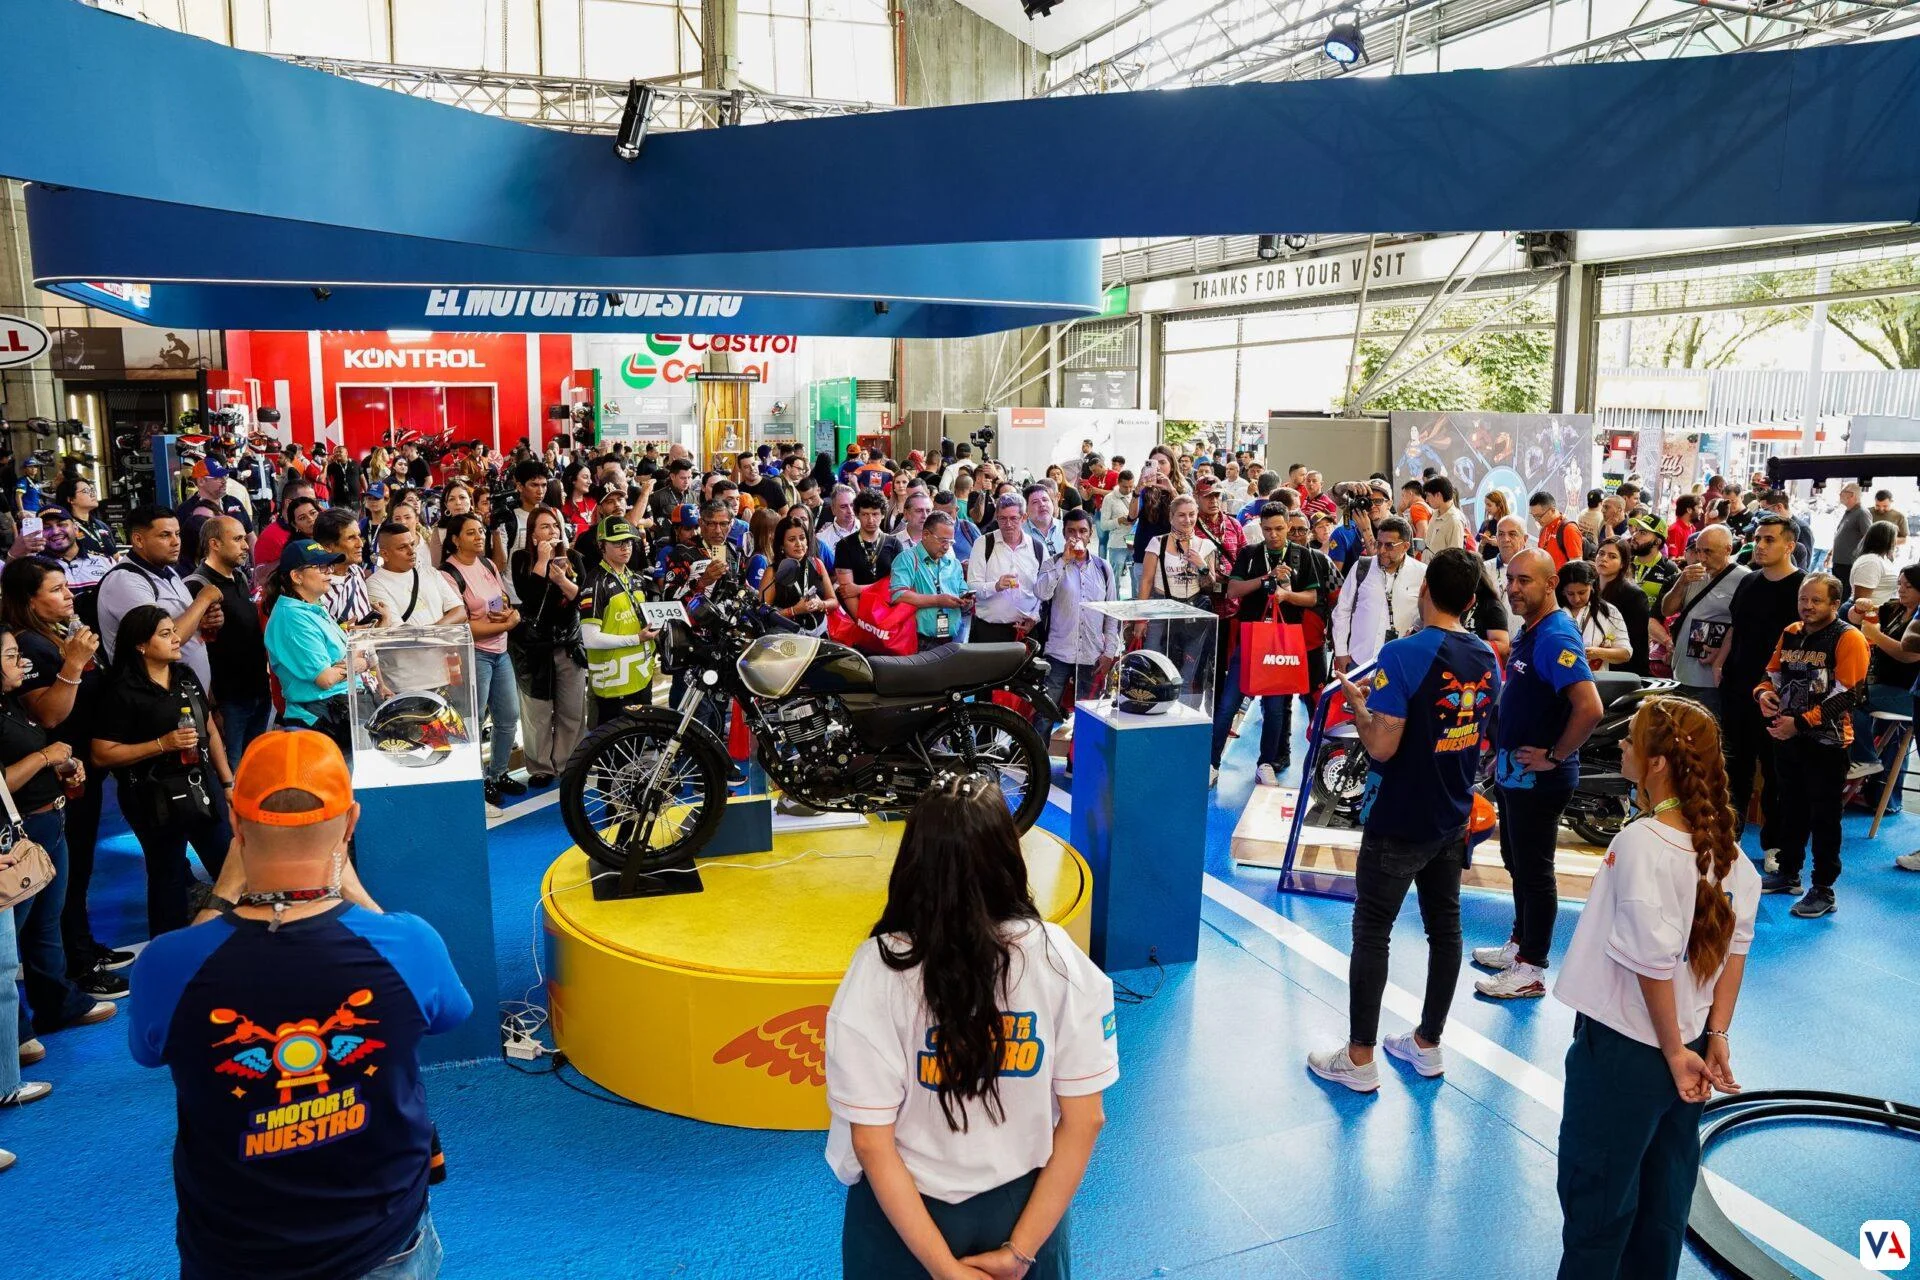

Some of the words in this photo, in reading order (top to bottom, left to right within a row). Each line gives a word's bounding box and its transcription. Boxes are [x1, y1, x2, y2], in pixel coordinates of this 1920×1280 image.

[1193, 274, 1247, 299] THANKS
[1257, 269, 1285, 291] FOR
[1296, 261, 1340, 287] YOUR
[1352, 252, 1405, 281] VSIT
[425, 289, 461, 316] EL
[462, 290, 576, 317] MOTOR
[577, 300, 599, 317] LO
[602, 292, 743, 317] NUESTRO
[687, 334, 798, 353] Castrol
[343, 348, 486, 369] KONTROL
[647, 608, 682, 619] 1349
[857, 618, 890, 640] MOTUL
[1262, 654, 1301, 666] MOTUL
[1435, 732, 1480, 753] NUESTRO
[1017, 1016, 1031, 1028] DE
[1016, 1027, 1031, 1040] LO
[343, 1087, 355, 1099] DE
[343, 1096, 356, 1109] LO
[255, 1112, 267, 1125] EL
[267, 1092, 341, 1131] MOTOR
[245, 1102, 367, 1157] NUESTRO
